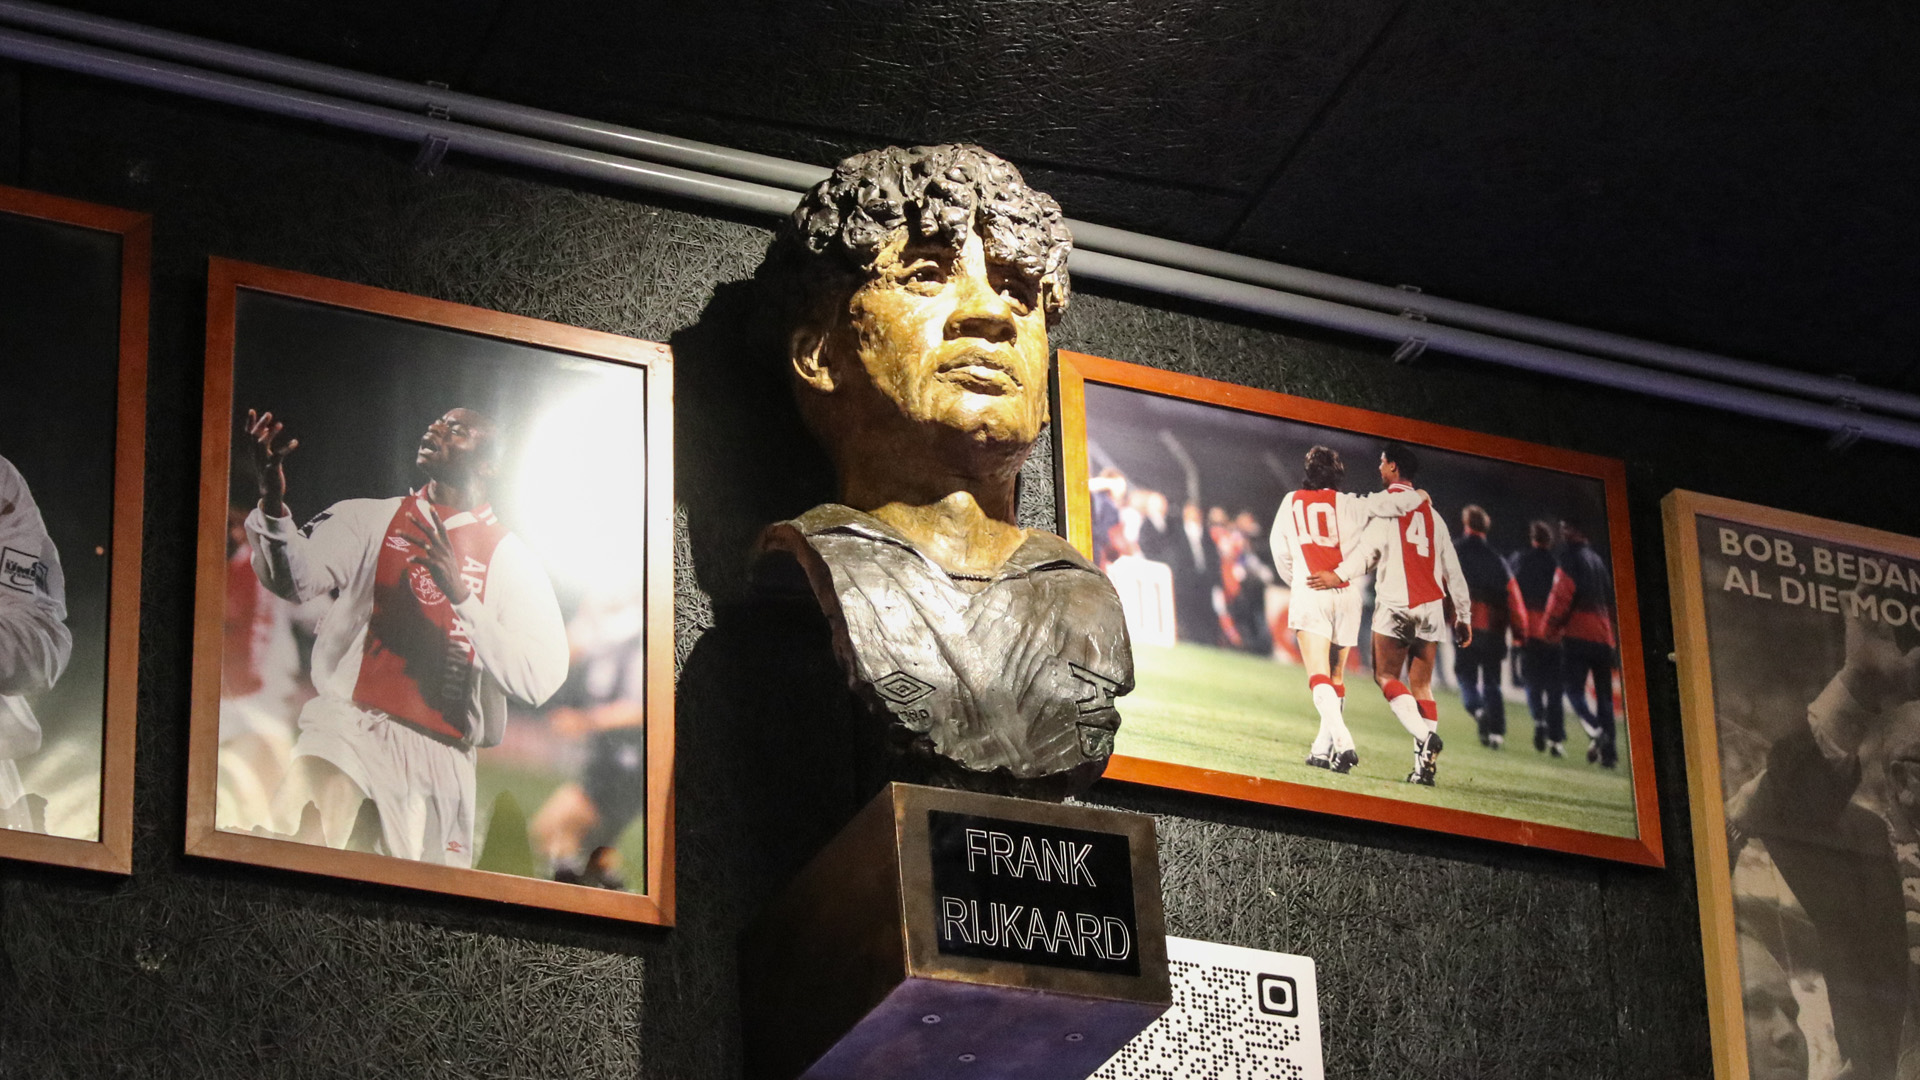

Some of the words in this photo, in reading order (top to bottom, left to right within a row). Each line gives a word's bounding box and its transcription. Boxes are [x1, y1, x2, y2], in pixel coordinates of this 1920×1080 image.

[1292, 498, 1340, 548] 10
[1405, 511, 1430, 558] 4
[1718, 527, 1807, 576] BOB,
[1723, 566, 1773, 600] AL
[1779, 576, 1840, 614] DIE
[965, 828, 1097, 888] FRANK
[942, 896, 1131, 961] RIJKAARD
